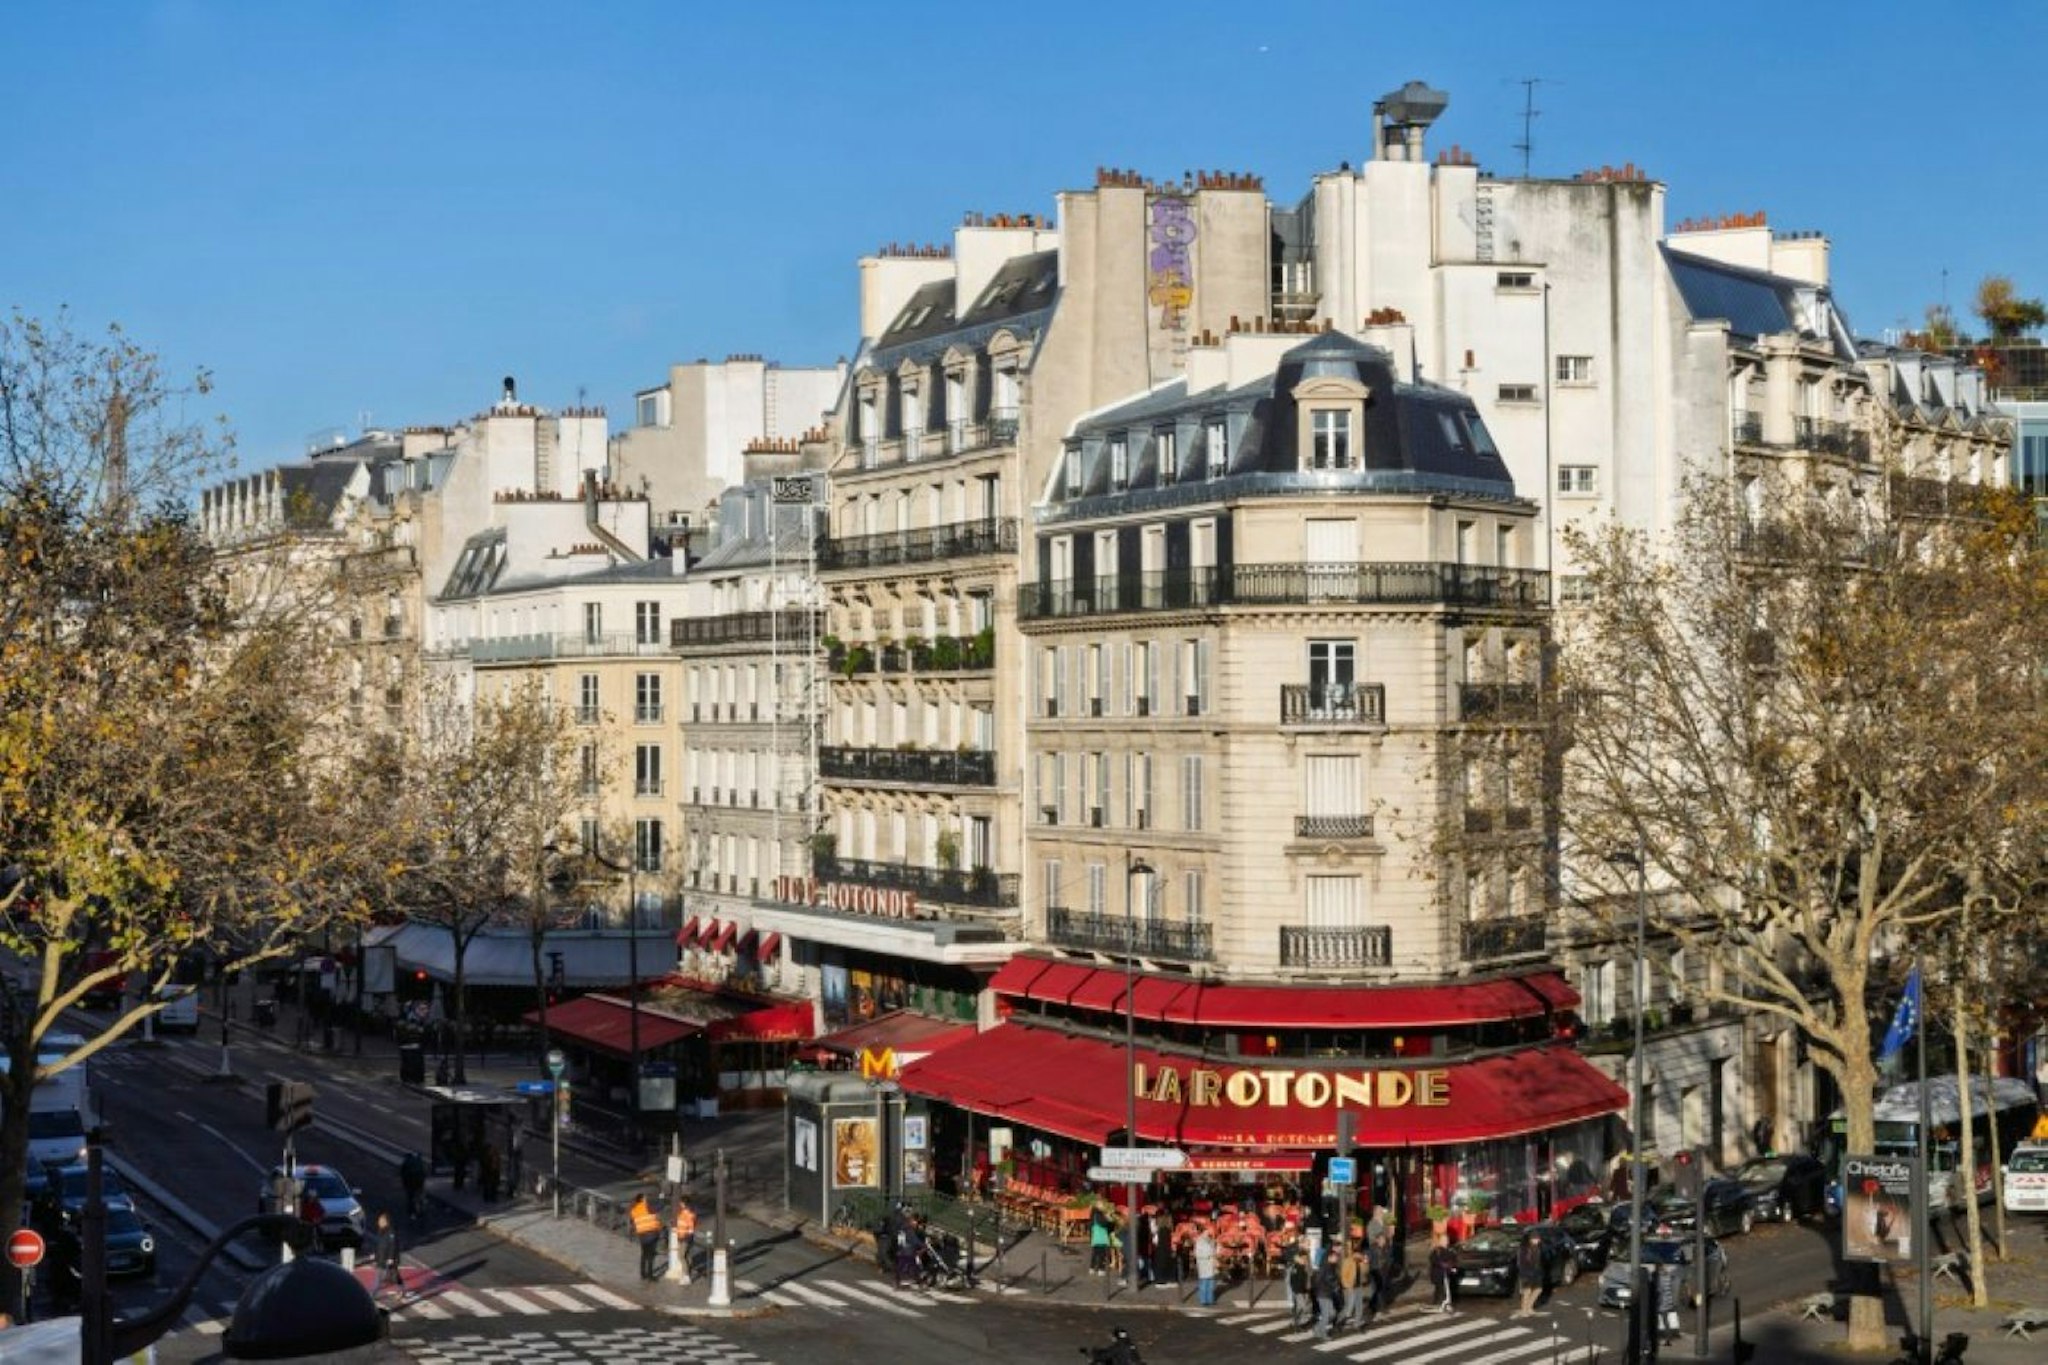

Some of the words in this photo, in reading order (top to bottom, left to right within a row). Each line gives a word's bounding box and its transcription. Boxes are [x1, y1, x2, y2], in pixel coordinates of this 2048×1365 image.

[826, 881, 914, 919] ROTONDE
[862, 1046, 893, 1079] M
[1134, 1063, 1182, 1104] LA
[1188, 1069, 1451, 1108] ROTONDE
